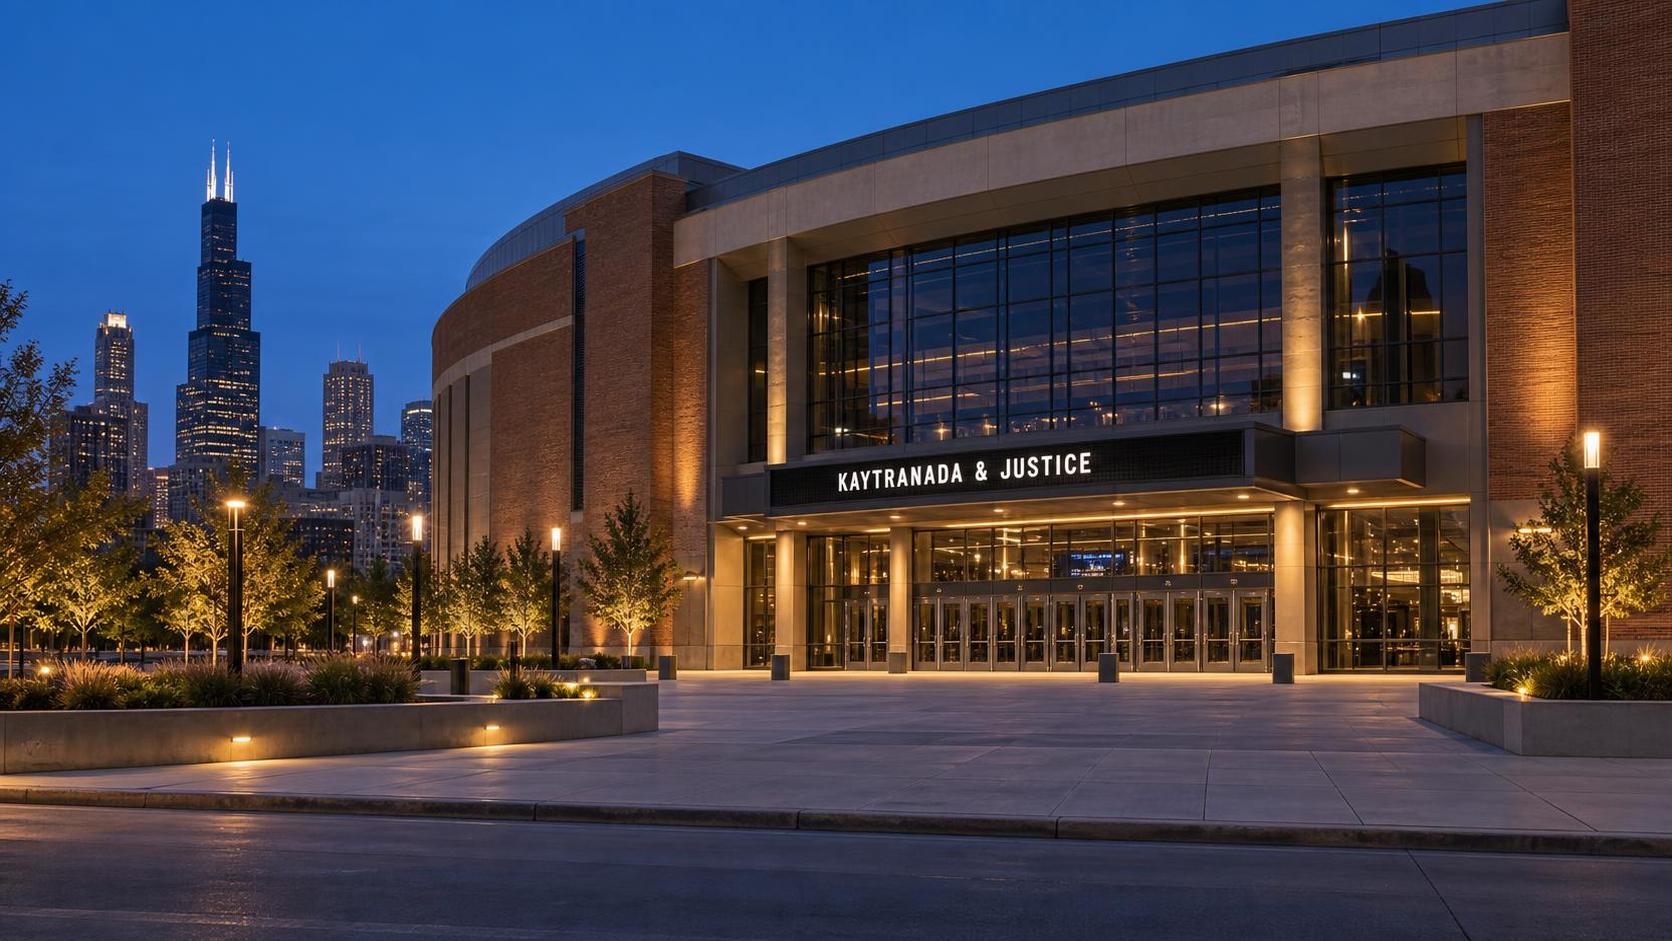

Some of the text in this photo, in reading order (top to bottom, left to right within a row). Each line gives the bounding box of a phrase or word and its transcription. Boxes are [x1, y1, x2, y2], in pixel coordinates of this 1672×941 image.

[838, 451, 1092, 493] KAYTRANADA & JUSTICE
